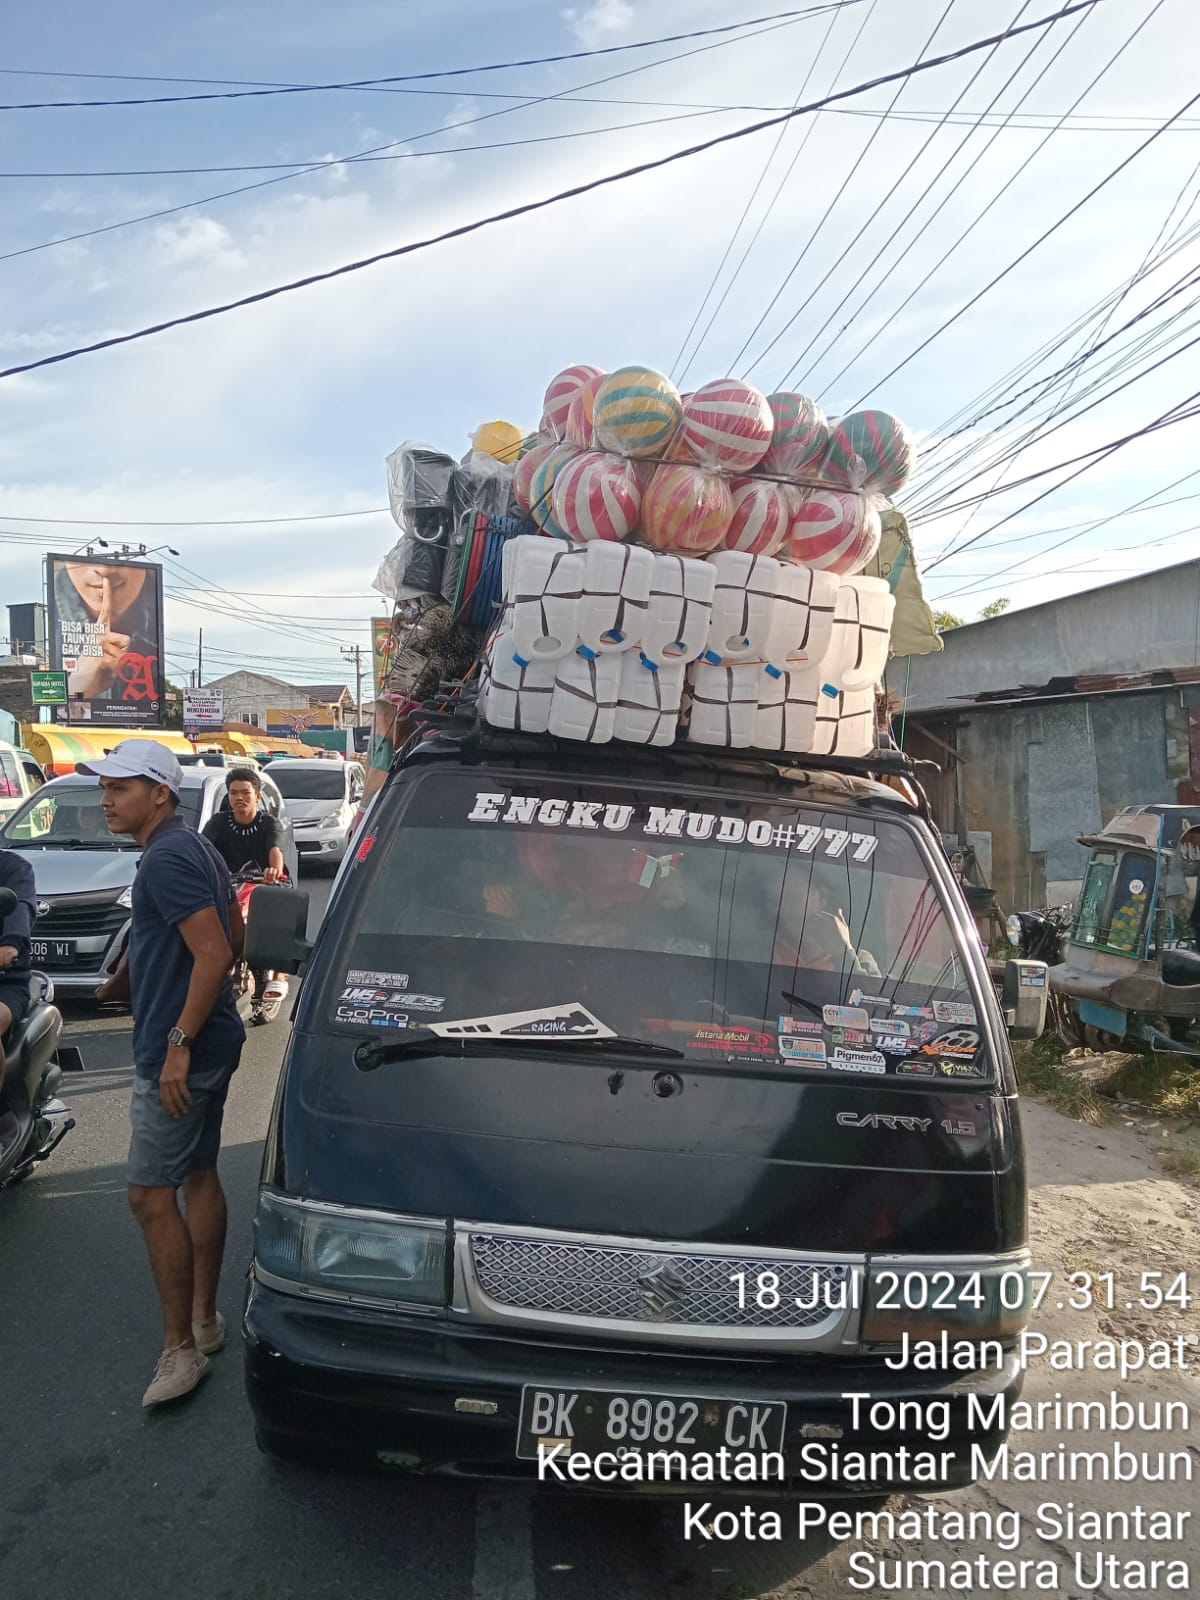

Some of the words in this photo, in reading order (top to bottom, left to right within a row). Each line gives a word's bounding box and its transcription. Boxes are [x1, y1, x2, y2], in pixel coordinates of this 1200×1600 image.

[61, 621, 82, 633] BISA
[84, 623, 105, 634] BISA
[62, 633, 97, 645] TAUNYA
[61, 644, 81, 656] GAK
[83, 645, 104, 657] BISA
[467, 791, 634, 831] ENGKU
[642, 805, 879, 863] MUDO#777
[56, 943, 69, 956] WI
[336, 1006, 409, 1023] GoPro
[531, 1021, 567, 1034] RACING
[724, 1031, 750, 1042] Mobil
[836, 1112, 933, 1132] CARRY
[940, 1119, 977, 1136] 1.5
[529, 1391, 579, 1437] BK
[605, 1396, 697, 1444] 8982
[723, 1404, 773, 1450] CK
